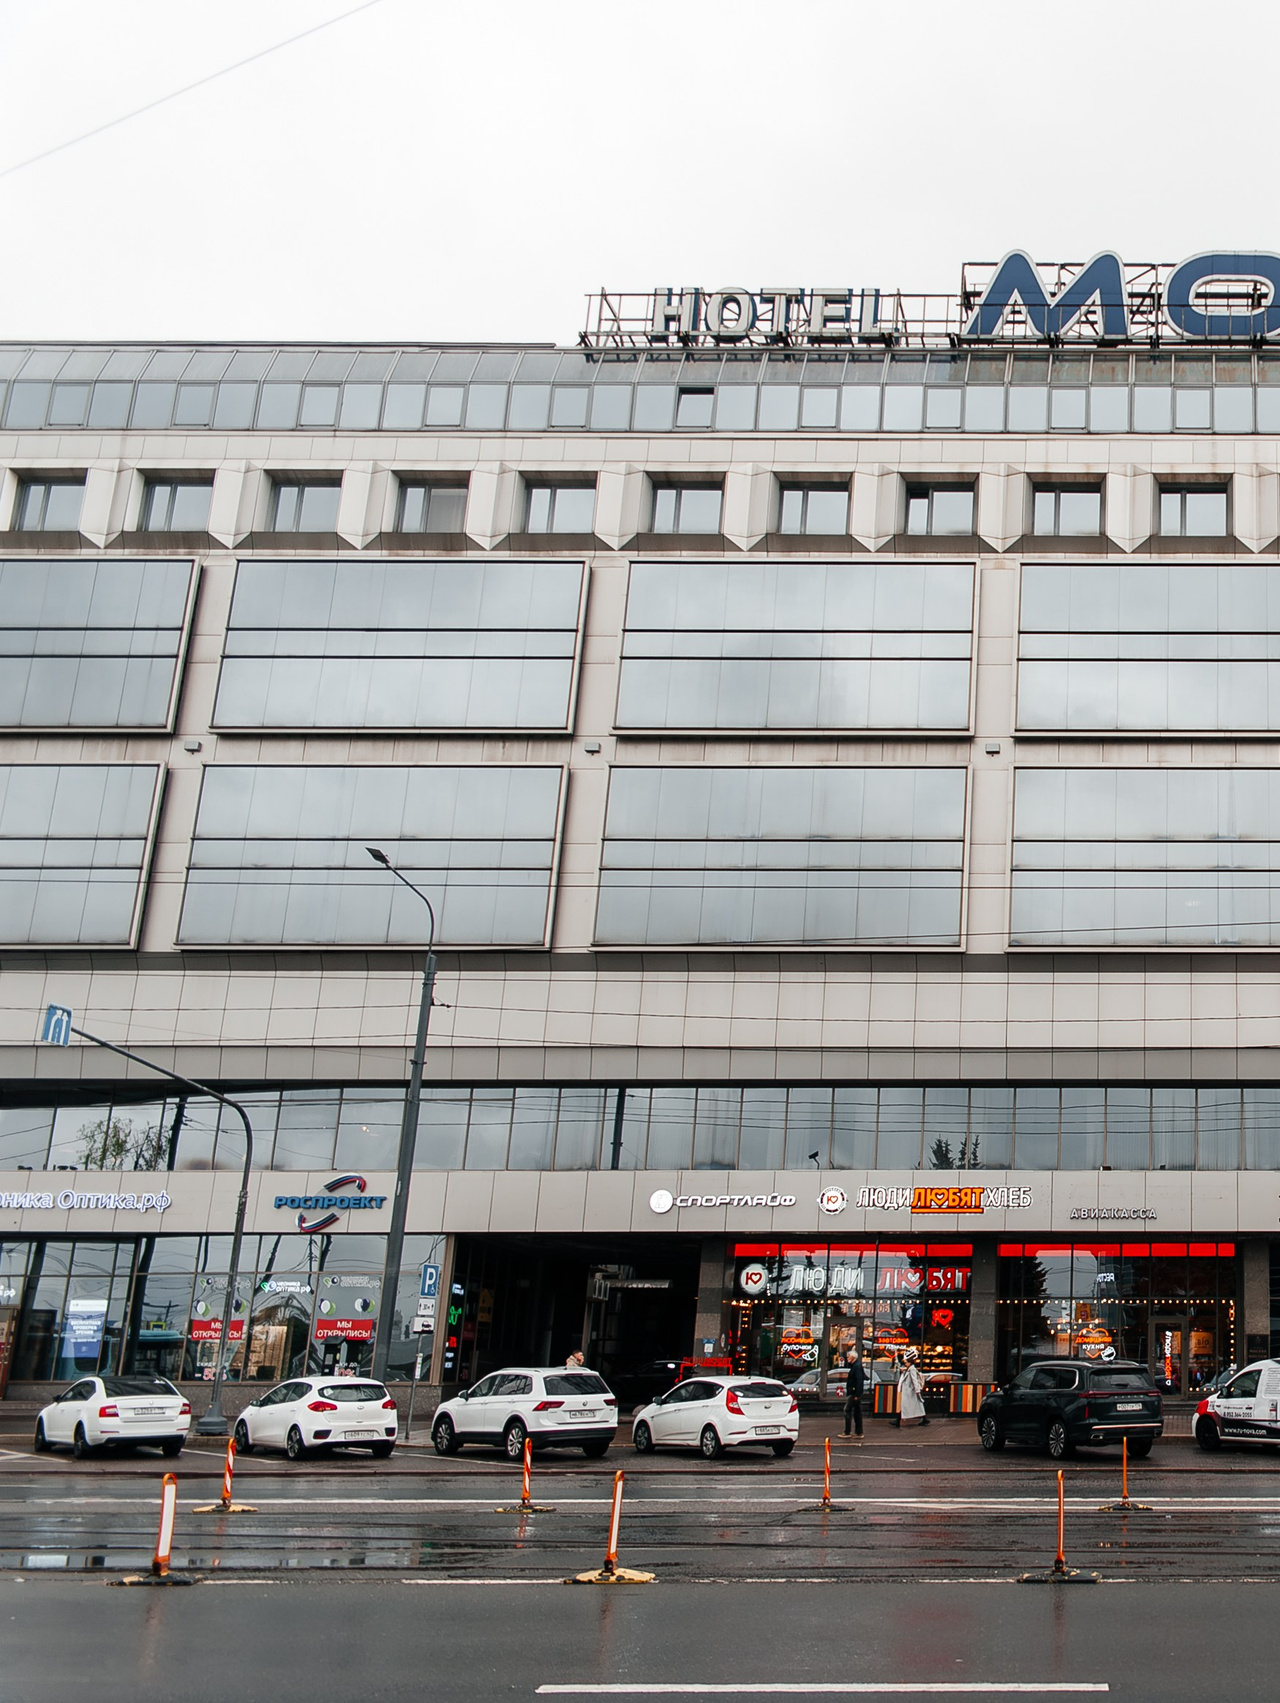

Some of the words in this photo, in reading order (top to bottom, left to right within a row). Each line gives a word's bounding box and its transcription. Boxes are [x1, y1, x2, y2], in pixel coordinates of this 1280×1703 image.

[651, 287, 899, 340] HOTEL
[0, 1192, 54, 1209] ника
[58, 1190, 171, 1213] Оптика.рф
[274, 1195, 387, 1209] РОСПРОЕКТ
[676, 1193, 796, 1207] СПОРТЛАЙФ
[1070, 1208, 1158, 1220] АВИАКАССА
[424, 1268, 436, 1293] P
[337, 1321, 352, 1329] МЫ
